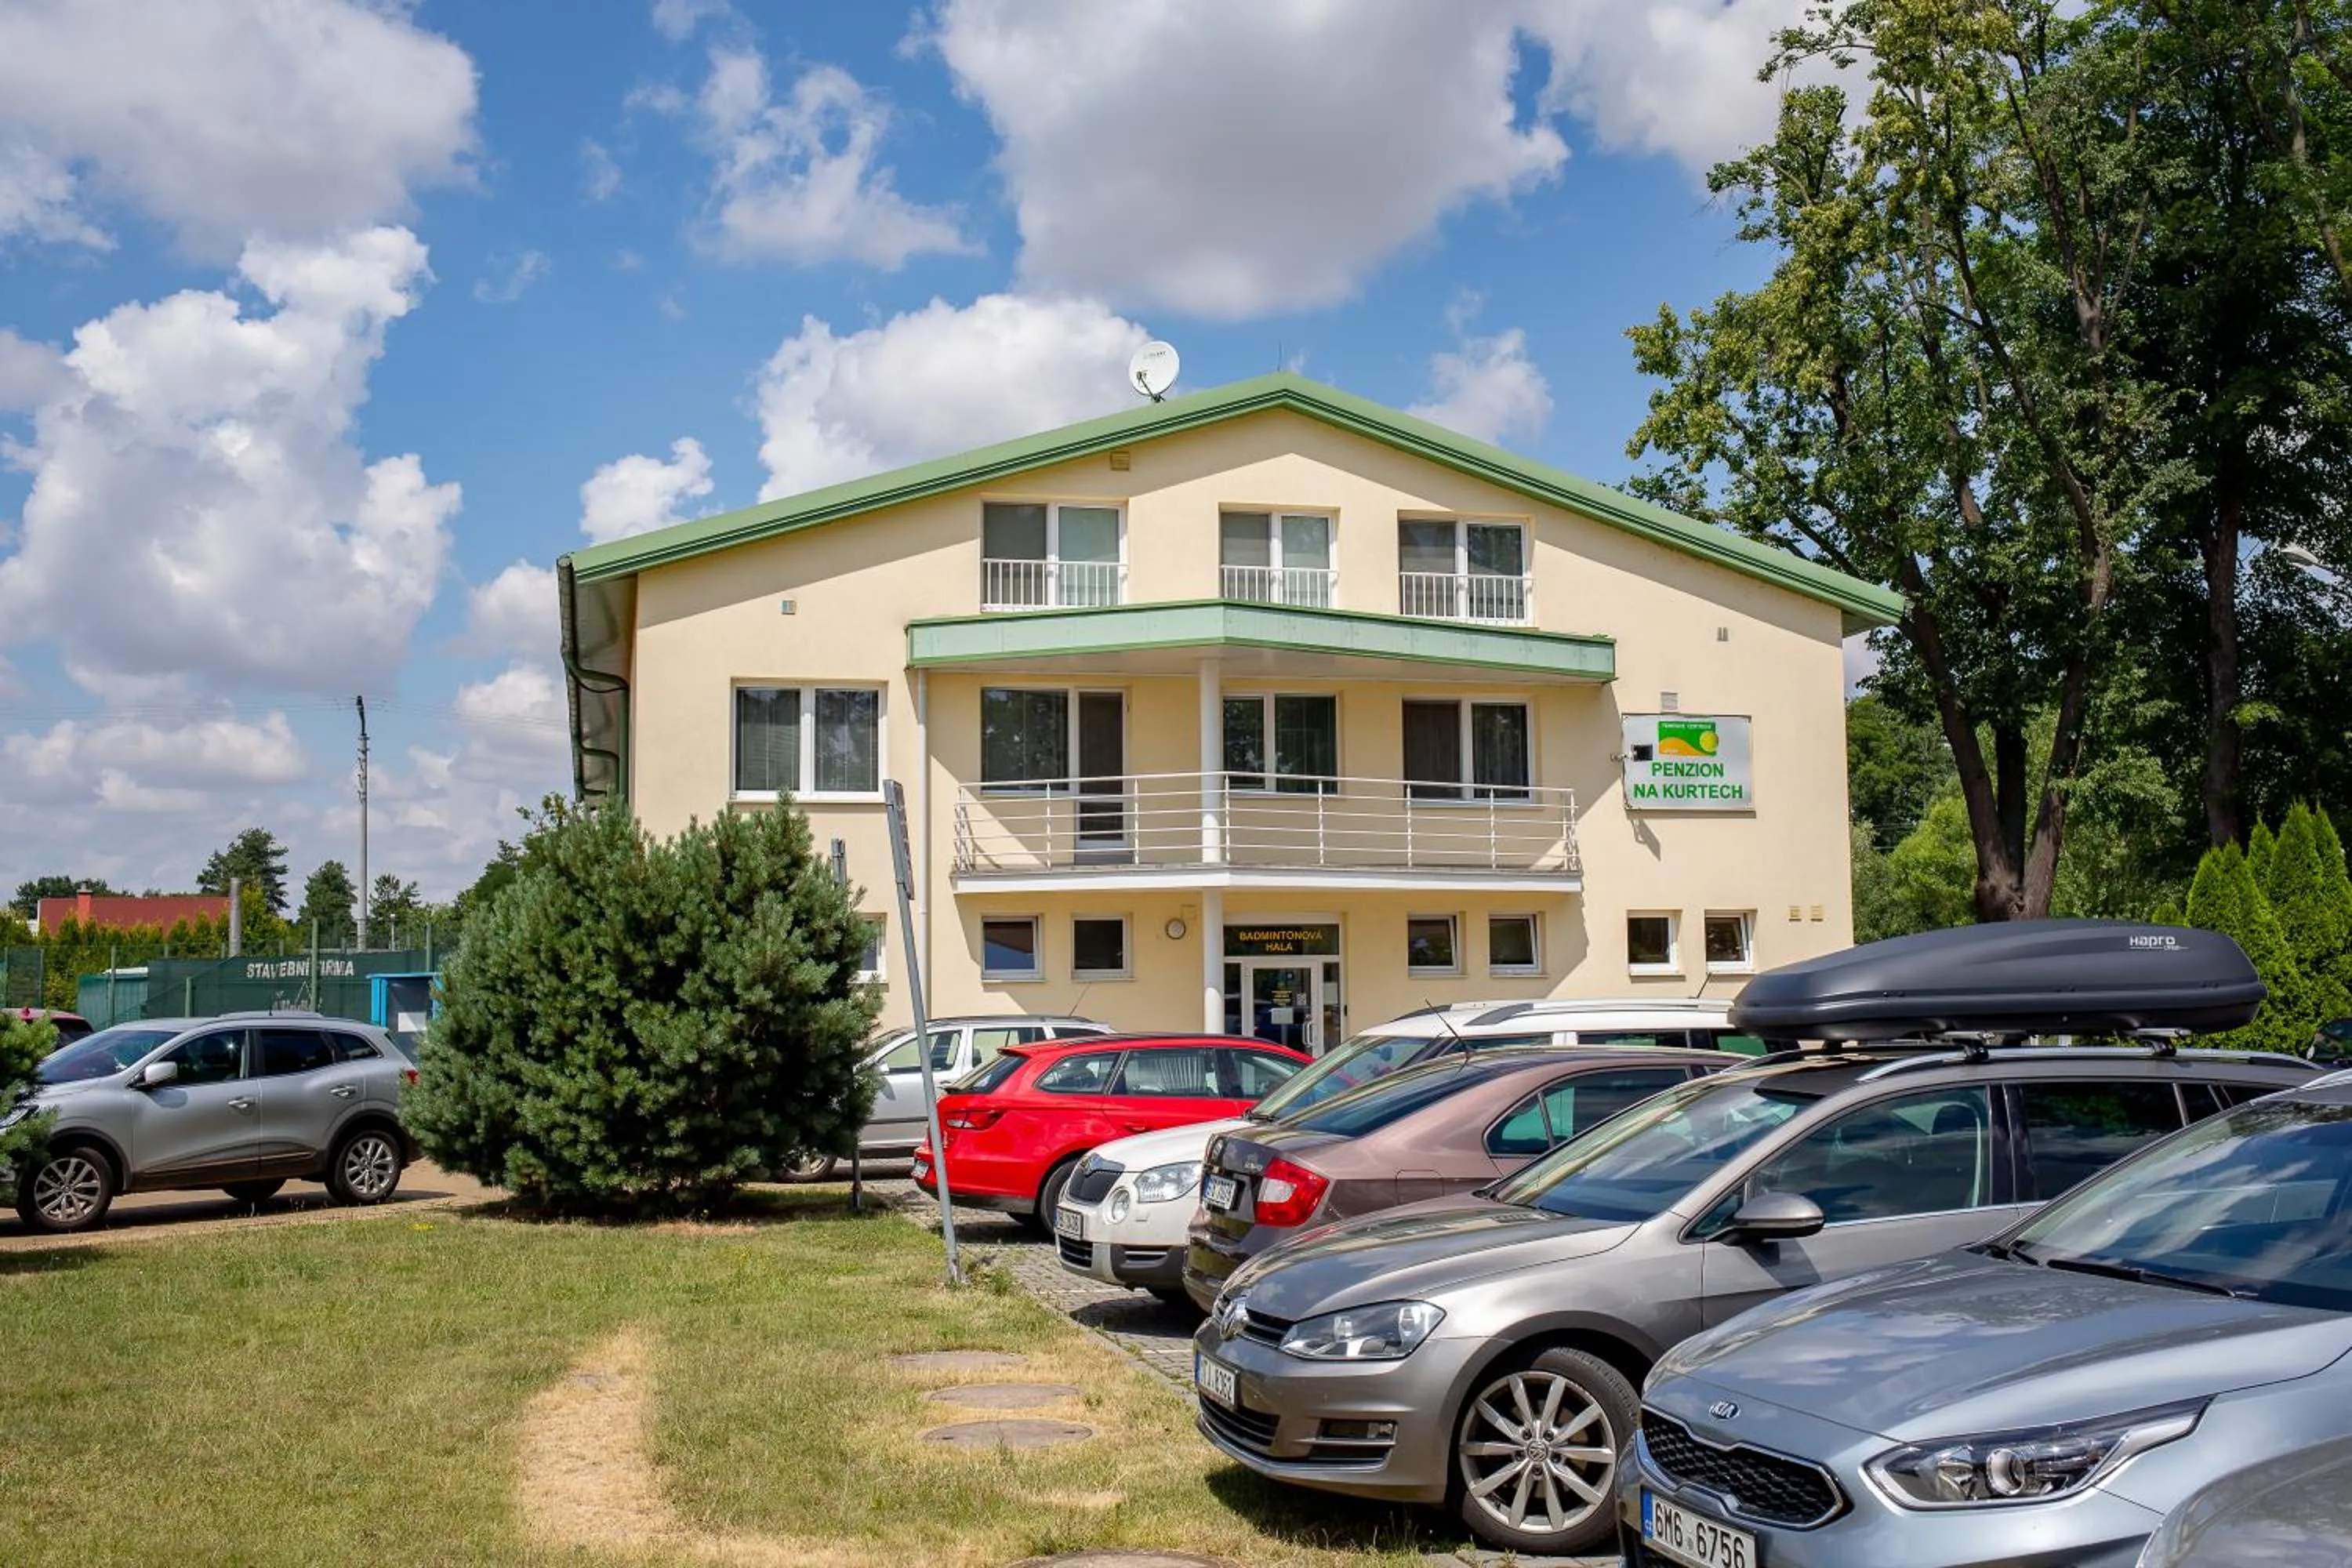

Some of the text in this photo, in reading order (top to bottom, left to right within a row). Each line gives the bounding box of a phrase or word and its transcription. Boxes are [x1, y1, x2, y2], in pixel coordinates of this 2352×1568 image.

[1652, 762, 1724, 777] PENZION
[1633, 783, 1743, 799] NA KURTECH
[1266, 942, 1293, 951] HALA
[247, 957, 355, 978] STAVEBNÍ IRMA
[1655, 1501, 1683, 1548] 6M6
[1696, 1522, 1745, 1568] 6756
